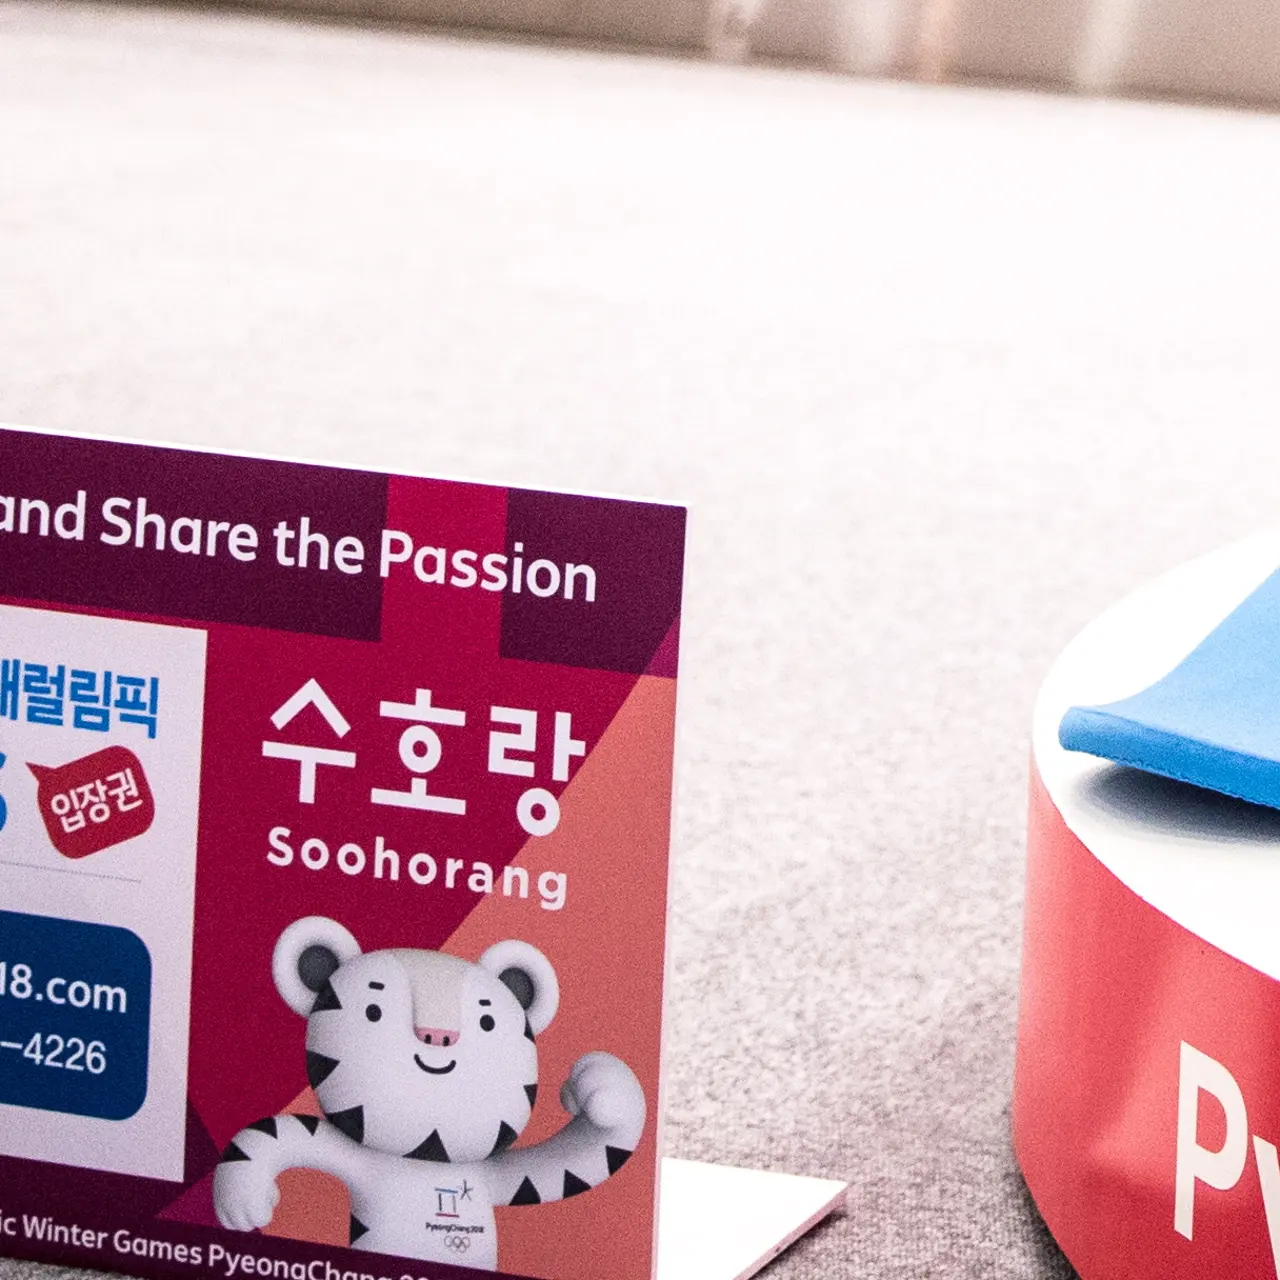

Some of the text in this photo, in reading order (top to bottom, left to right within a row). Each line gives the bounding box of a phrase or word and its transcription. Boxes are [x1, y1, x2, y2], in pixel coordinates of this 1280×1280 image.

[100, 497, 258, 562] Share
[273, 516, 365, 575] the
[379, 529, 597, 602] Passion
[50, 767, 143, 834] 입장권
[262, 677, 587, 838] 수호랑
[266, 825, 568, 911] Soohorang
[22, 1214, 109, 1250] Winter
[113, 1229, 202, 1265] Games
